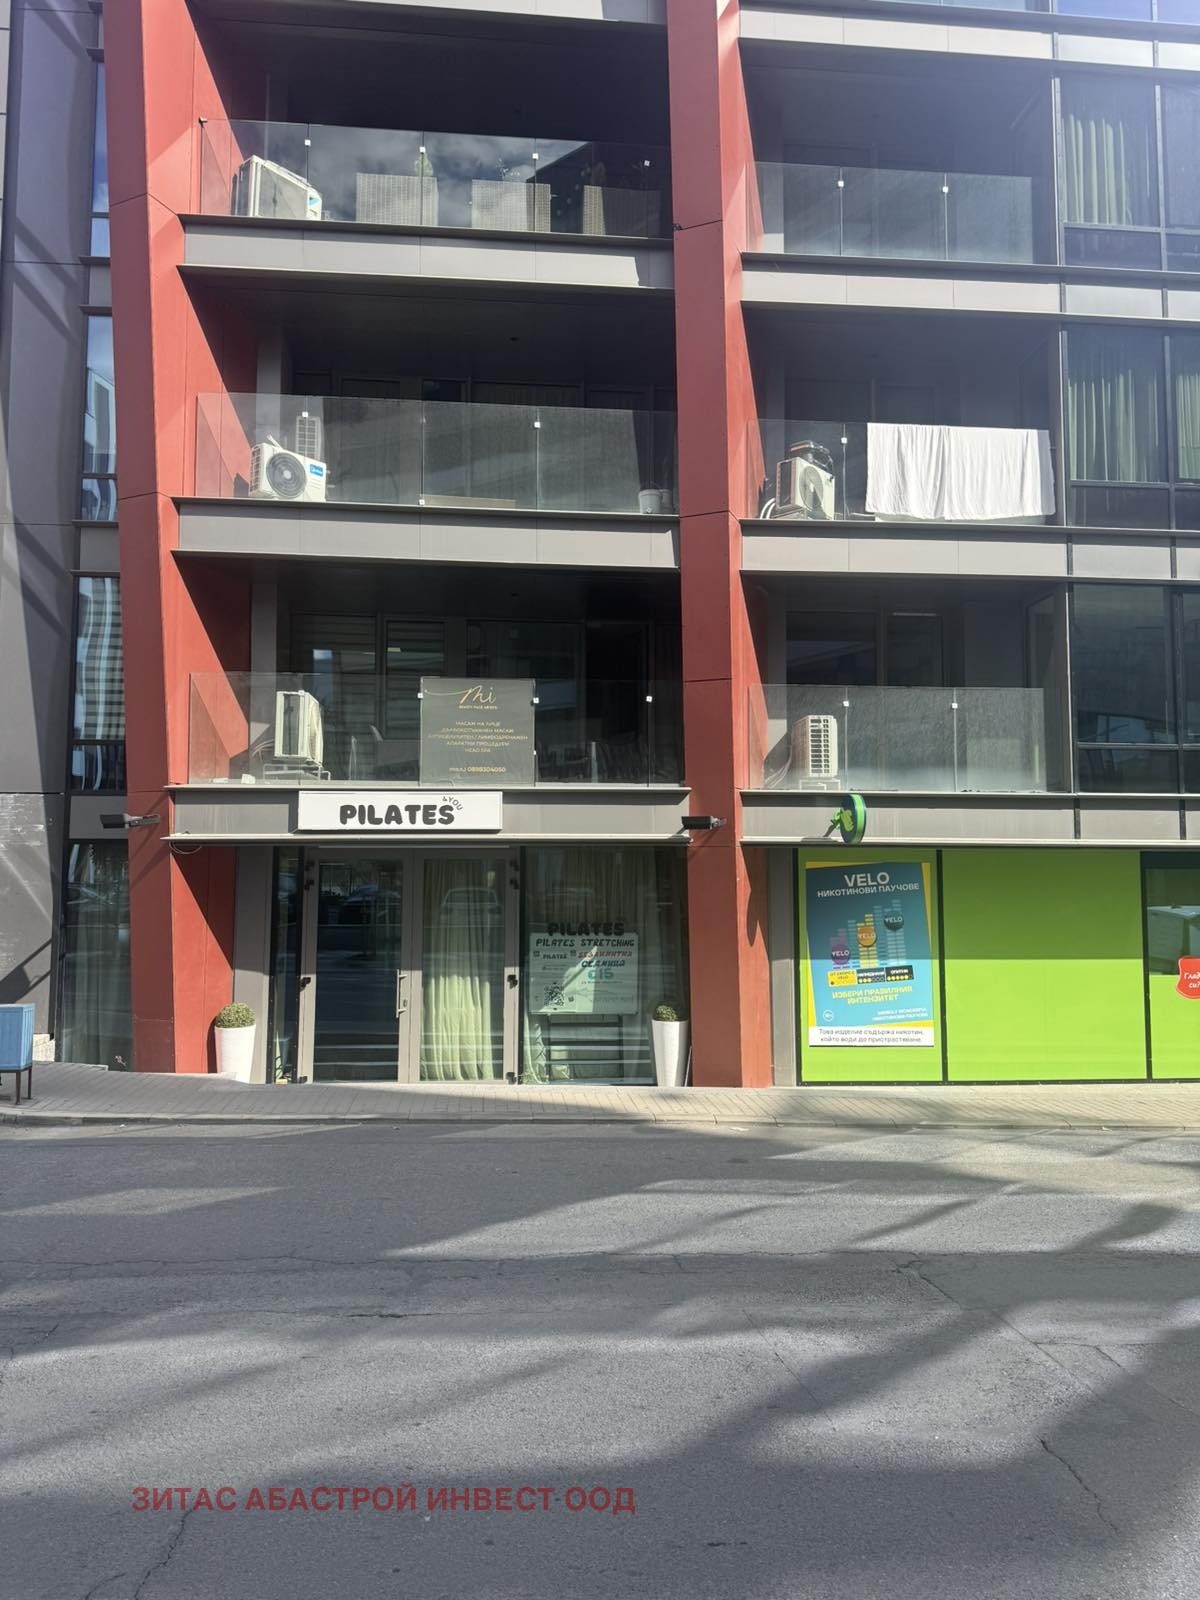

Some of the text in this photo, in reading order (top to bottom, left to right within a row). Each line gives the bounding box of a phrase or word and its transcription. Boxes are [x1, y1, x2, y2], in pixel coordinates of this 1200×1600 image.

[340, 804, 455, 825] PILATES
[844, 872, 890, 887] VELO
[817, 883, 919, 898] НИКОТИНОВИ ПАУЧОВЕ
[547, 922, 625, 937] PILATES
[536, 938, 635, 948] PILATES STRETCHING
[831, 949, 850, 957] VELO
